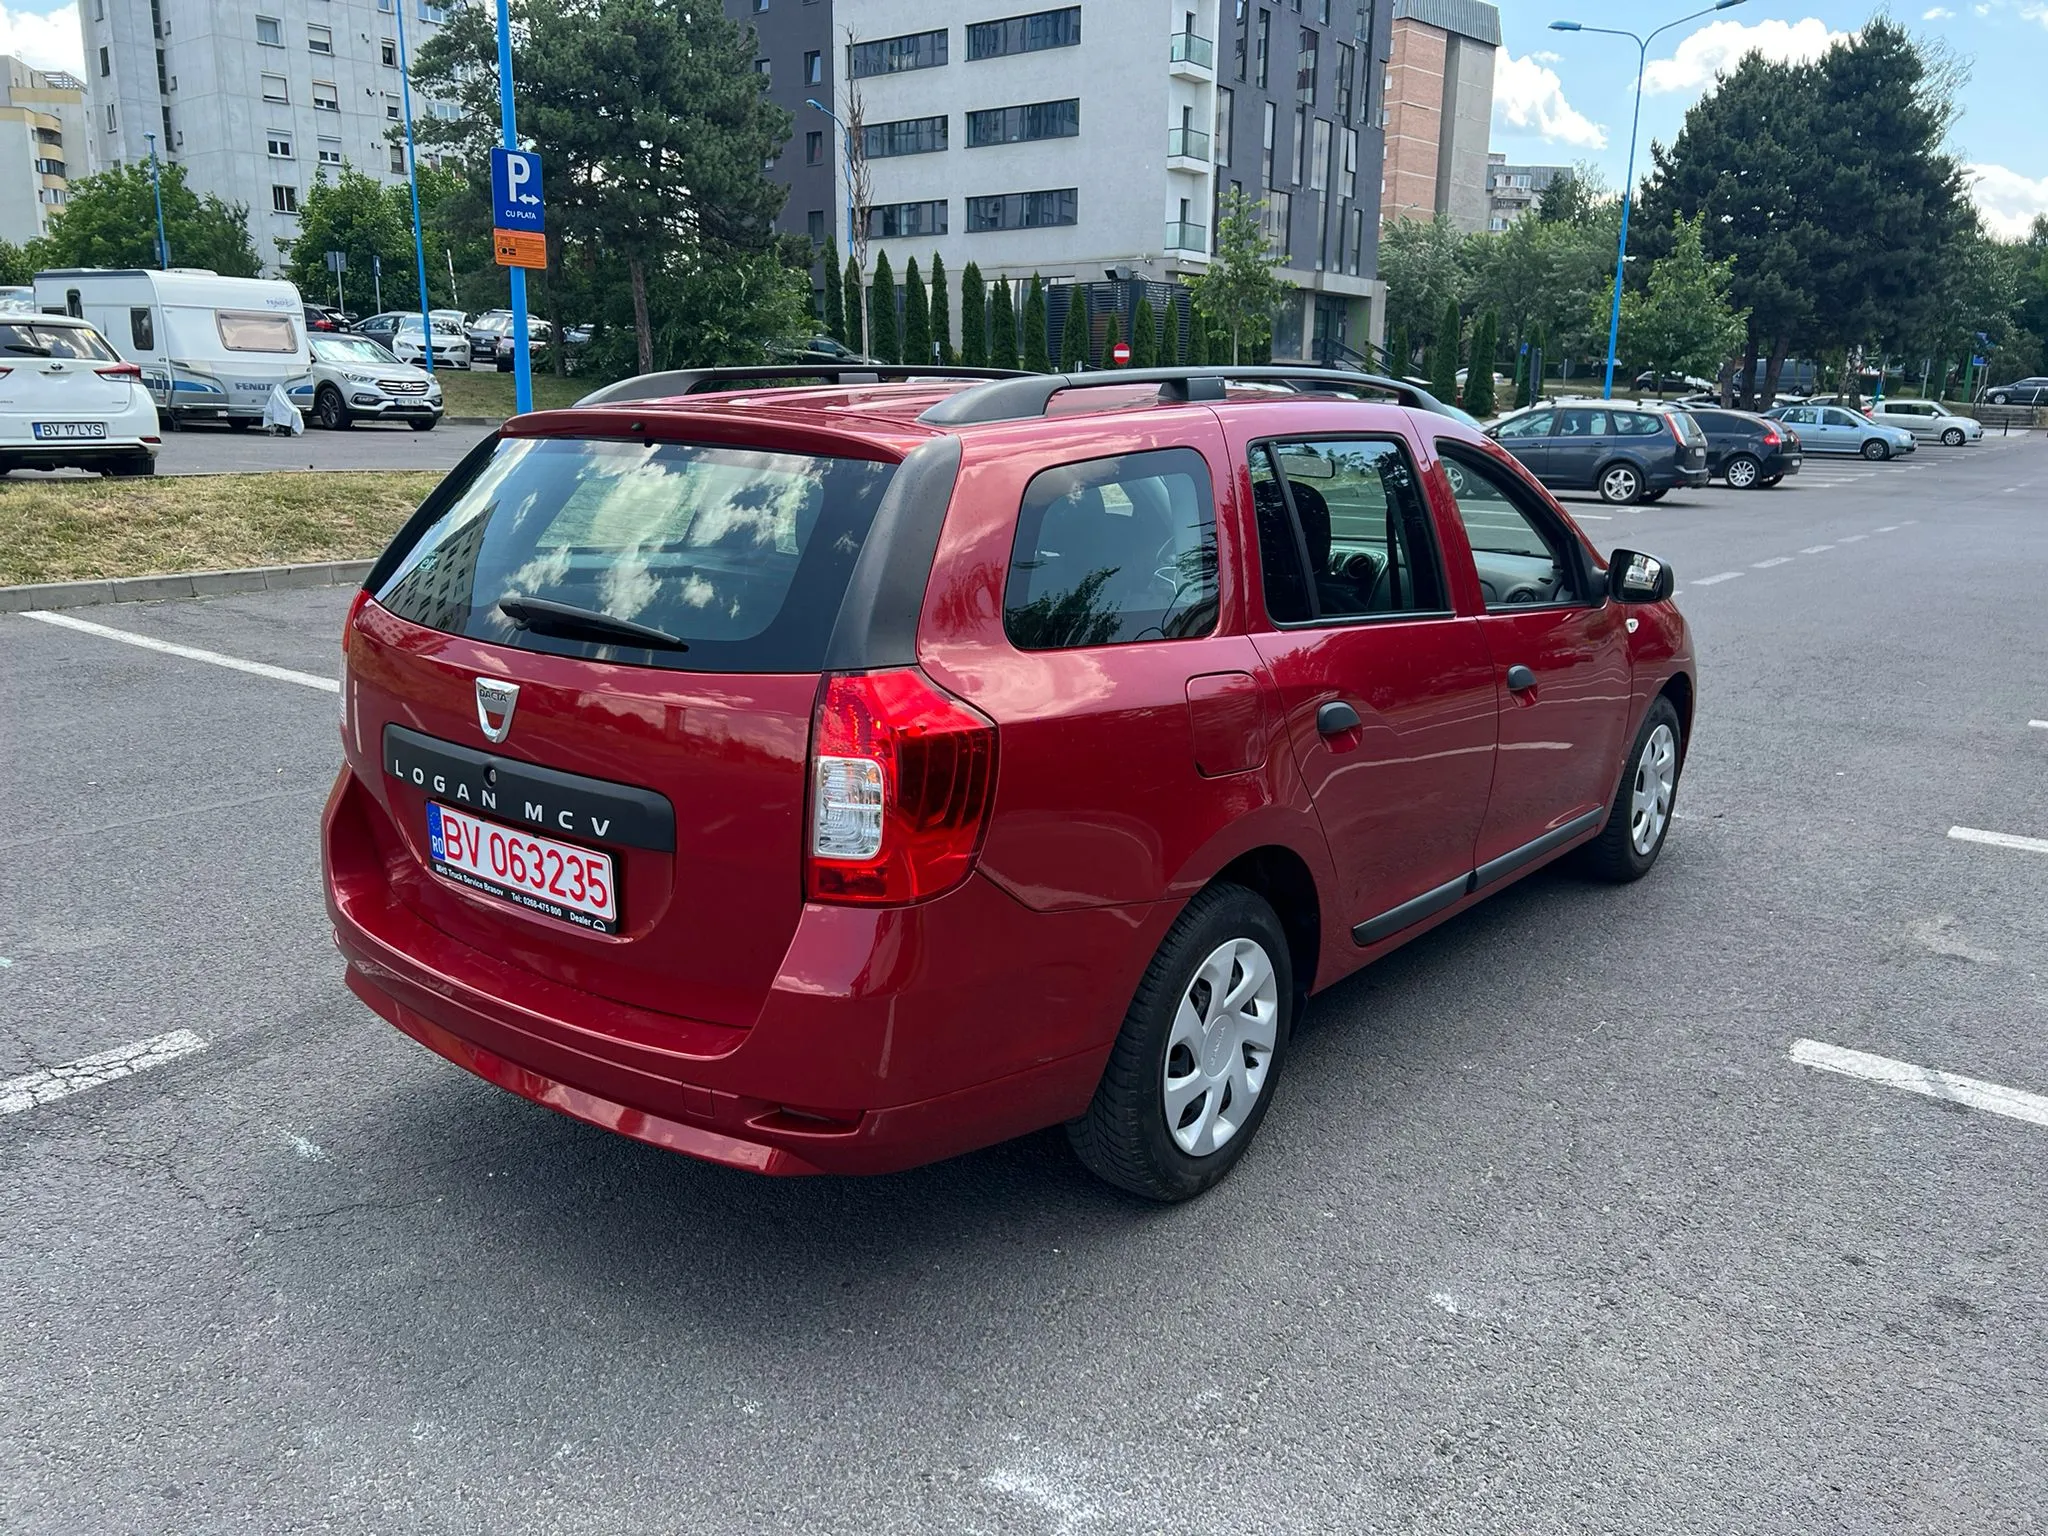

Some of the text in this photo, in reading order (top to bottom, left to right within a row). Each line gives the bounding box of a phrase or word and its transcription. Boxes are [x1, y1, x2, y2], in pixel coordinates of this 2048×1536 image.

[507, 154, 531, 202] P
[505, 210, 537, 219] CU PLATA
[234, 383, 273, 391] FENDT
[42, 424, 102, 436] BV 17 LYS
[479, 689, 507, 702] DACIA
[395, 759, 610, 837] LOGAN MCV
[431, 835, 444, 854] RO
[442, 814, 608, 909] BV 063235
[448, 869, 463, 881] Truck
[463, 874, 483, 889] Service
[483, 882, 504, 896] Brasov
[511, 892, 522, 903] Tel:
[570, 912, 591, 926] Dealer
